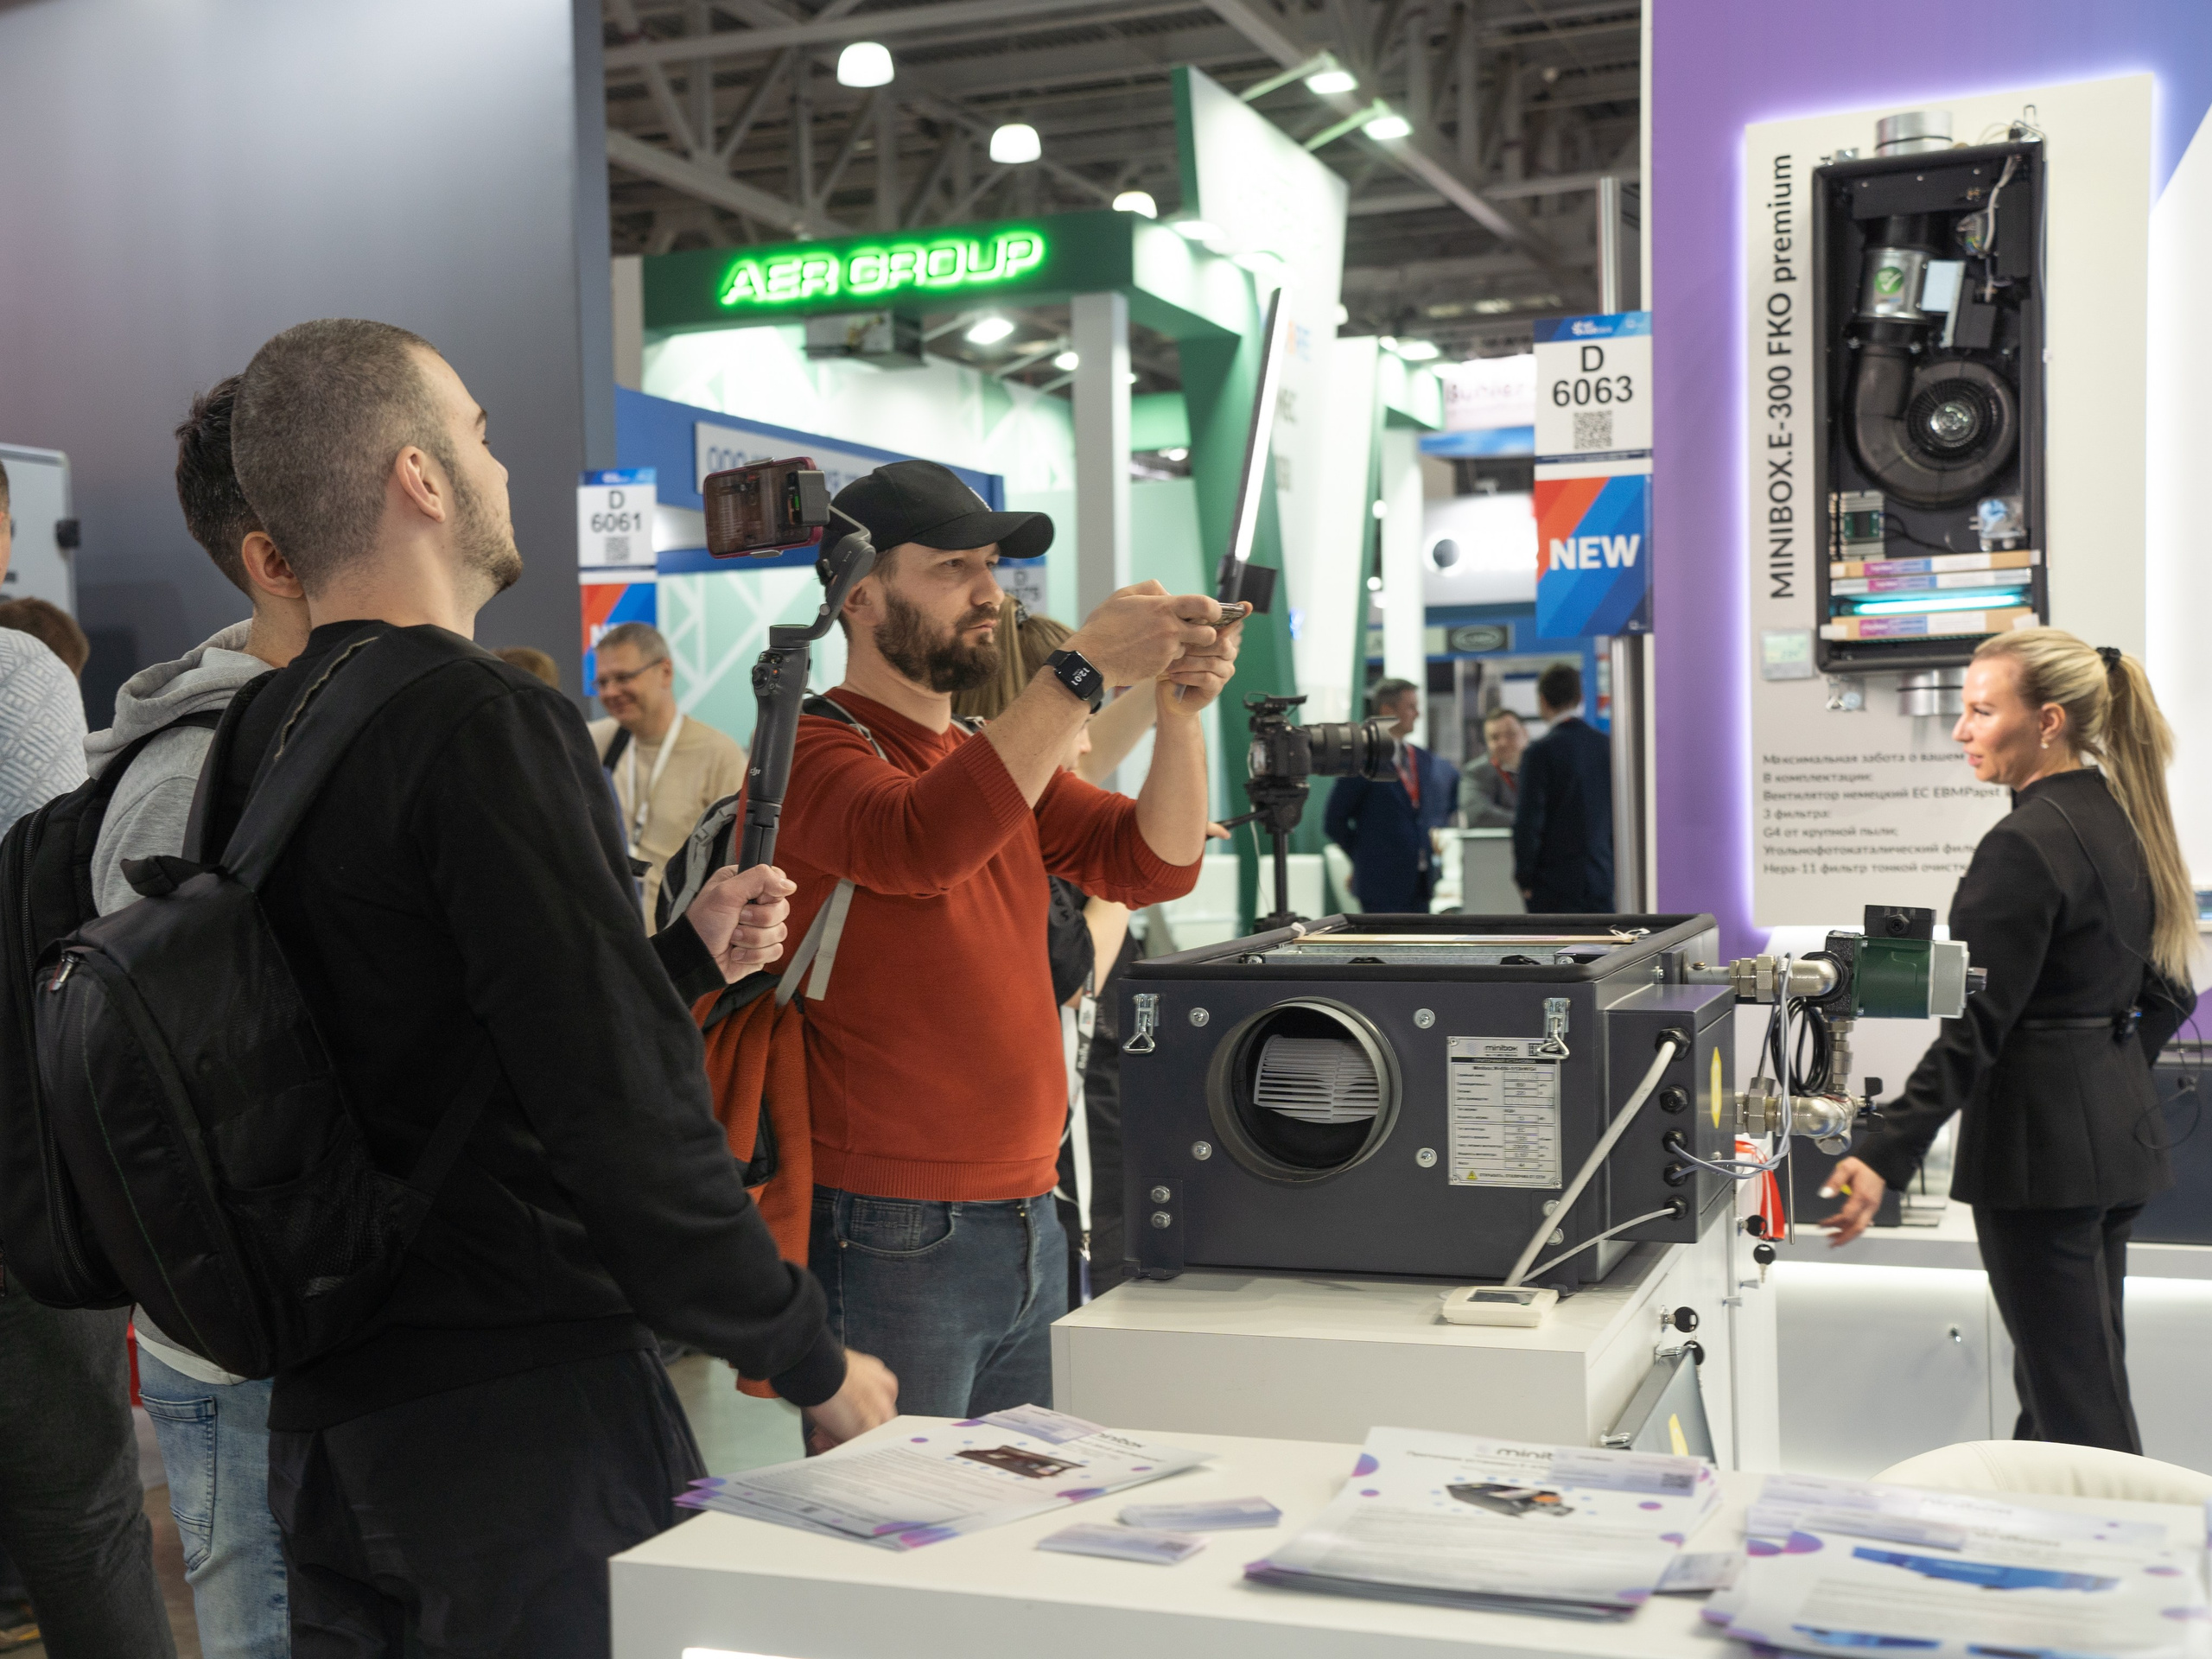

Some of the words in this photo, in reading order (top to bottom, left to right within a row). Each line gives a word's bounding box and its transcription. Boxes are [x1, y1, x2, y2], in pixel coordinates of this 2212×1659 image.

[1767, 154, 1797, 283] premium
[720, 252, 840, 305] AER
[847, 230, 1044, 295] GROUP
[1767, 292, 1793, 357] FKO
[1581, 345, 1605, 373] D
[1552, 375, 1634, 408] 6063
[1767, 365, 1795, 600] MINIBOX.E-300
[608, 489, 626, 510] D
[590, 512, 643, 534] 6061
[1549, 533, 1641, 571] NEW
[1763, 754, 1858, 765] Максимальная
[1861, 752, 1906, 764] забота
[1920, 753, 1966, 763] вашем
[1763, 790, 1840, 803] Вентилятор
[1842, 786, 1910, 801] немецкий
[1763, 809, 1771, 820] 3
[1784, 829, 1800, 838] от
[1802, 826, 1857, 839] крупной
[1819, 862, 1868, 876] фильтр
[1871, 861, 1918, 874] тонкой
[1921, 861, 1967, 874] очистк
[1484, 1044, 1519, 1052] minibox
